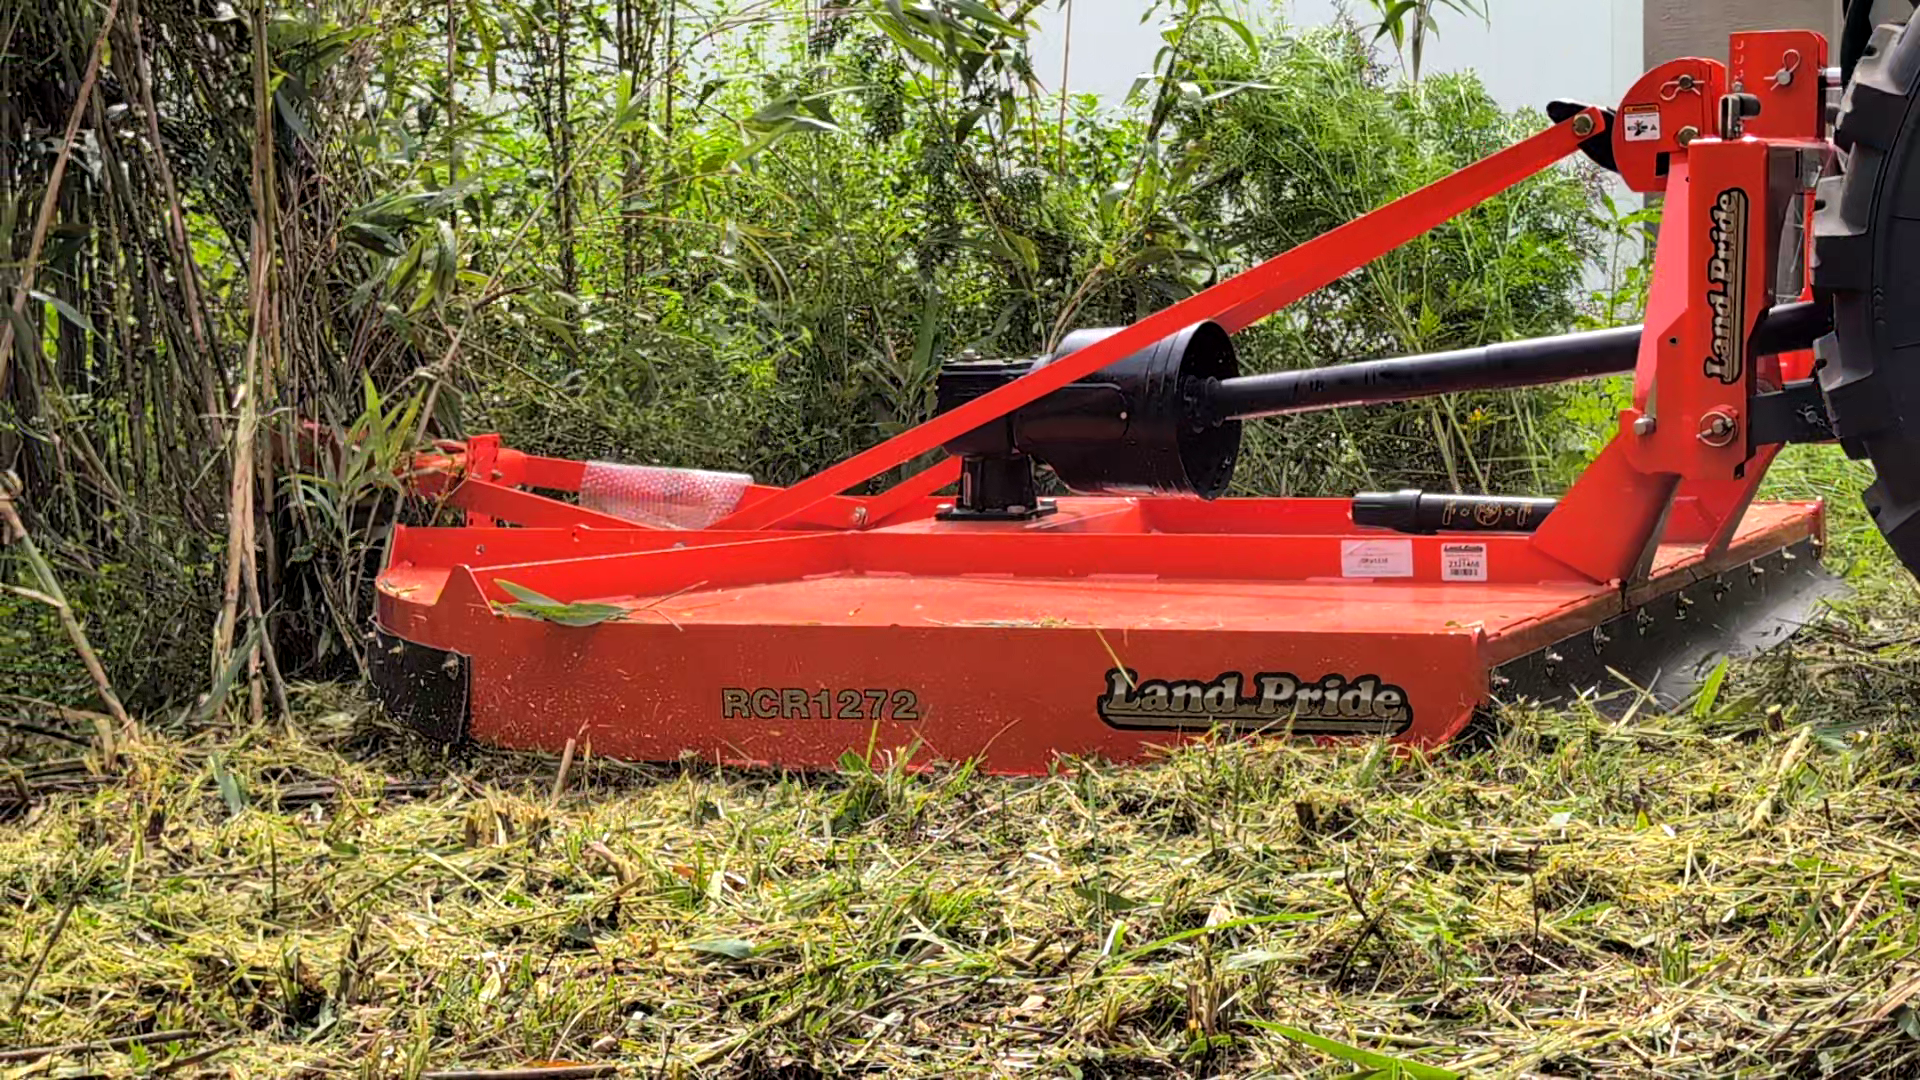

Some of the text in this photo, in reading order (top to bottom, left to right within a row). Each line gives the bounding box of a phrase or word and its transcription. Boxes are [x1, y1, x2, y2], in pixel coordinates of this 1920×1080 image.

[1705, 192, 1737, 379] Land Pride
[721, 687, 919, 720] RCR1272
[1106, 669, 1402, 717] Land Pride
